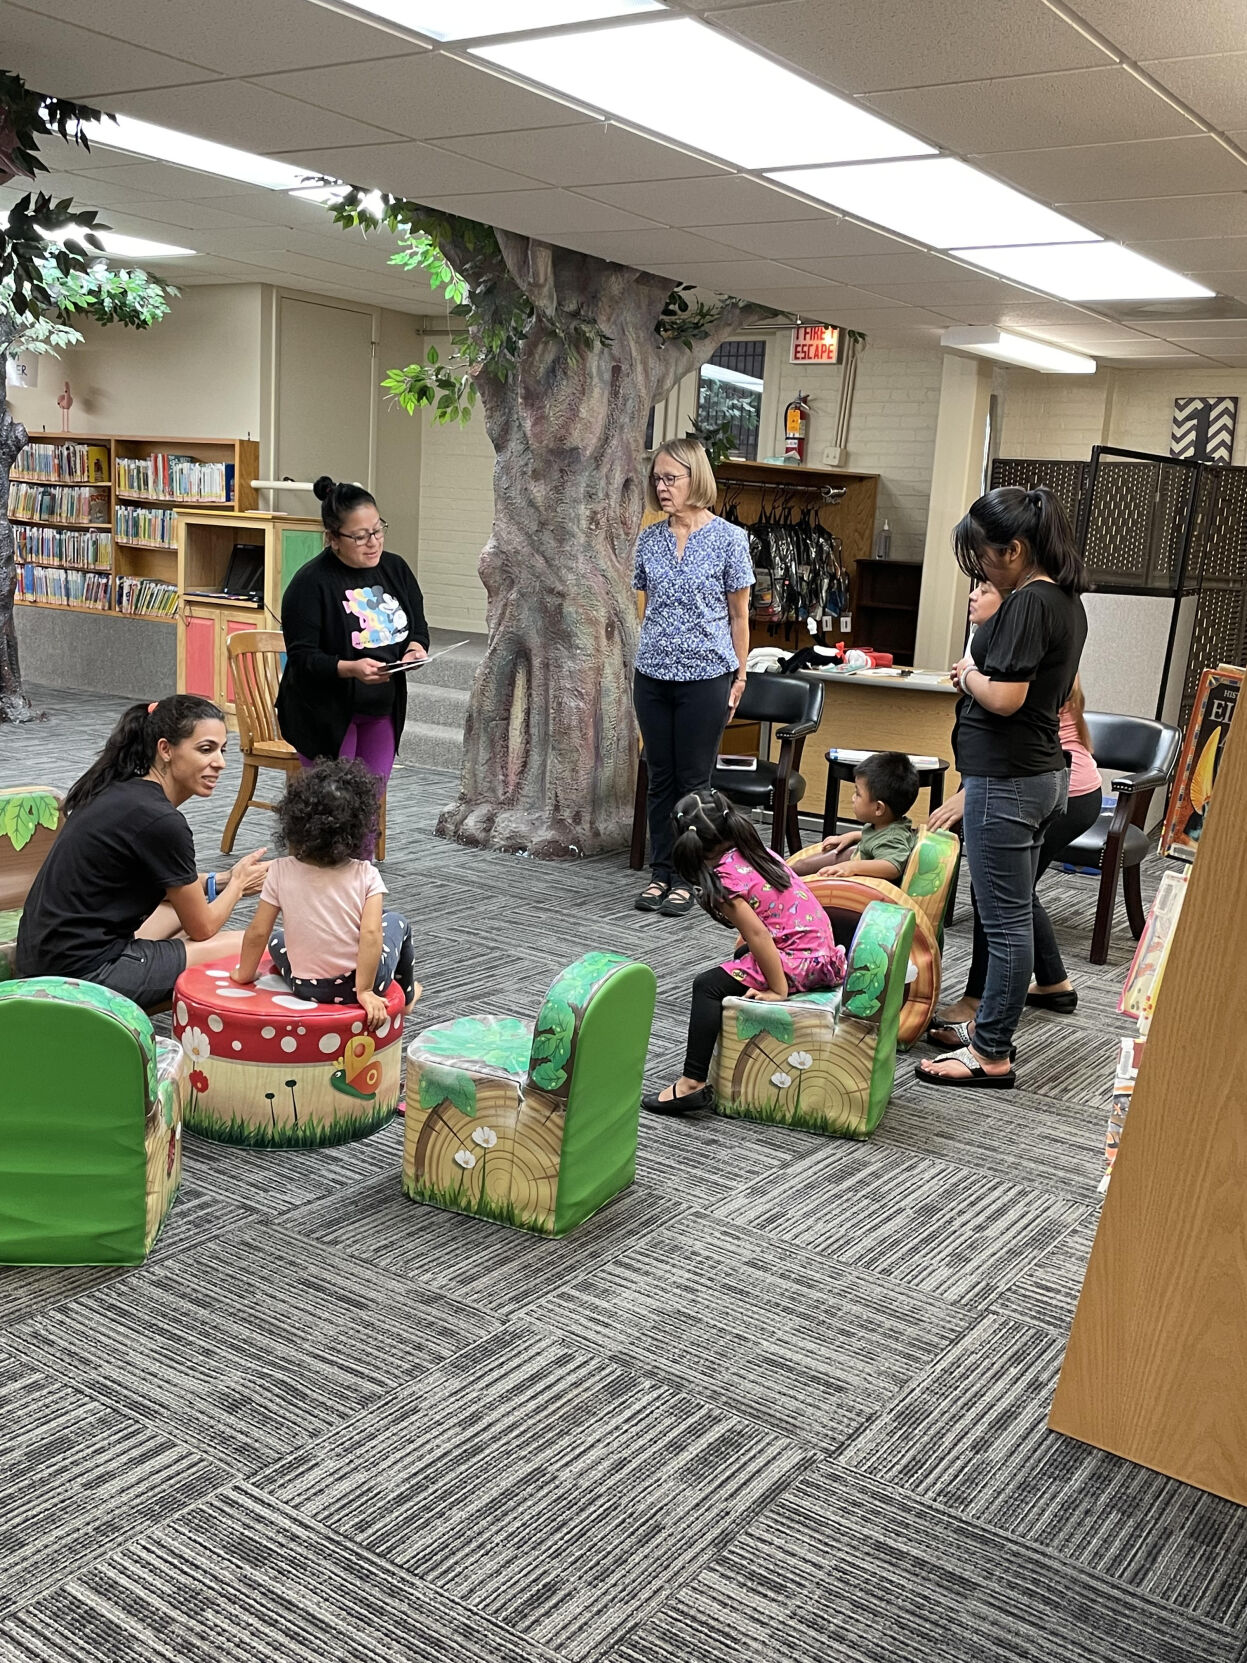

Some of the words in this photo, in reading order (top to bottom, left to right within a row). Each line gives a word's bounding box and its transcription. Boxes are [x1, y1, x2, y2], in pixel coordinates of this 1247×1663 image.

[803, 326, 826, 341] FIRE
[794, 343, 834, 360] ESCAPE
[1182, 403, 1215, 462] 1
